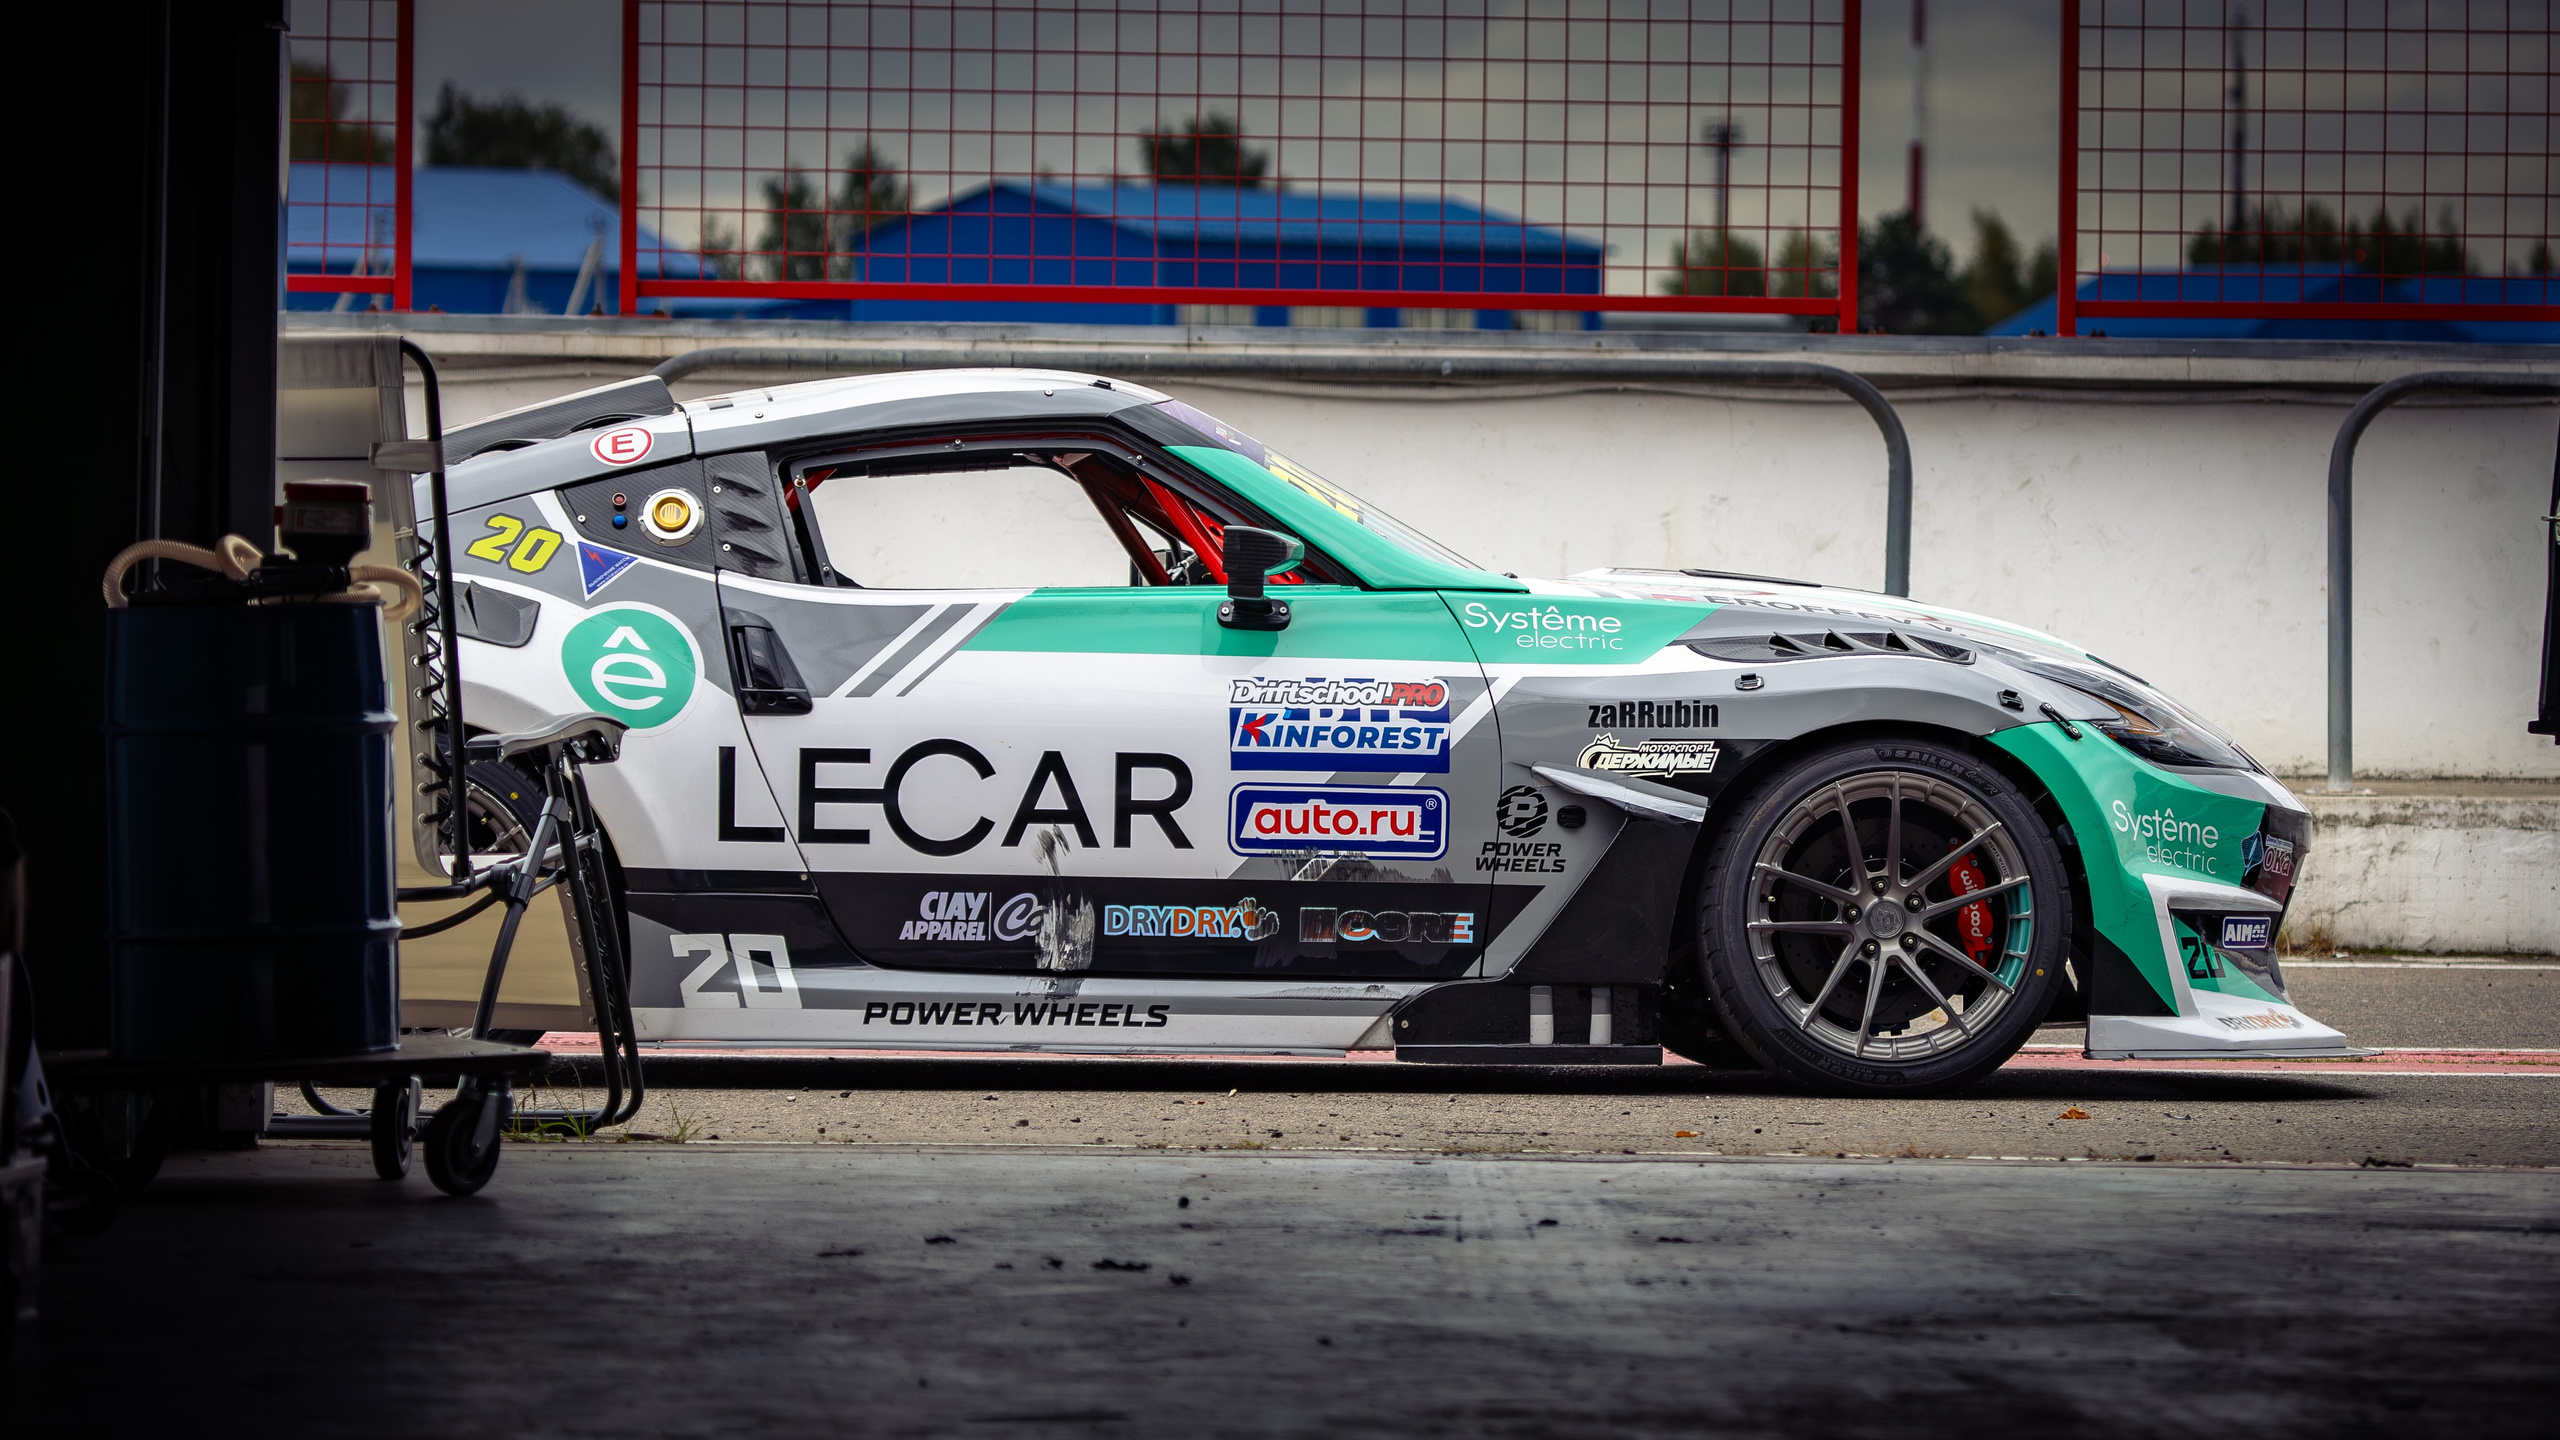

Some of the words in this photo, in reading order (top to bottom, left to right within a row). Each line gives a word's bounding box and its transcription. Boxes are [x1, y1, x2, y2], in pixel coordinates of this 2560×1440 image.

[612, 433, 635, 455] E
[465, 513, 564, 574] 20
[1463, 601, 1623, 634] Systême
[1515, 630, 1625, 651] electric
[1587, 699, 1719, 729] zaRRubin
[1237, 711, 1445, 751] KINFOREST
[1639, 743, 1710, 753] МОТОРСПОРТ
[1894, 749, 1965, 774] SAILUN
[717, 738, 1195, 857] LECAR
[1254, 804, 1415, 836] auto.ru
[2112, 799, 2219, 849] Systême
[1480, 841, 1562, 857] POWER
[2146, 840, 2217, 875] electric
[1475, 856, 1567, 873] WHEELS
[899, 920, 987, 942] APPAREL
[670, 934, 803, 1010] 20
[862, 1001, 1002, 1027] POWER
[1013, 1001, 1171, 1029] WHEELS
